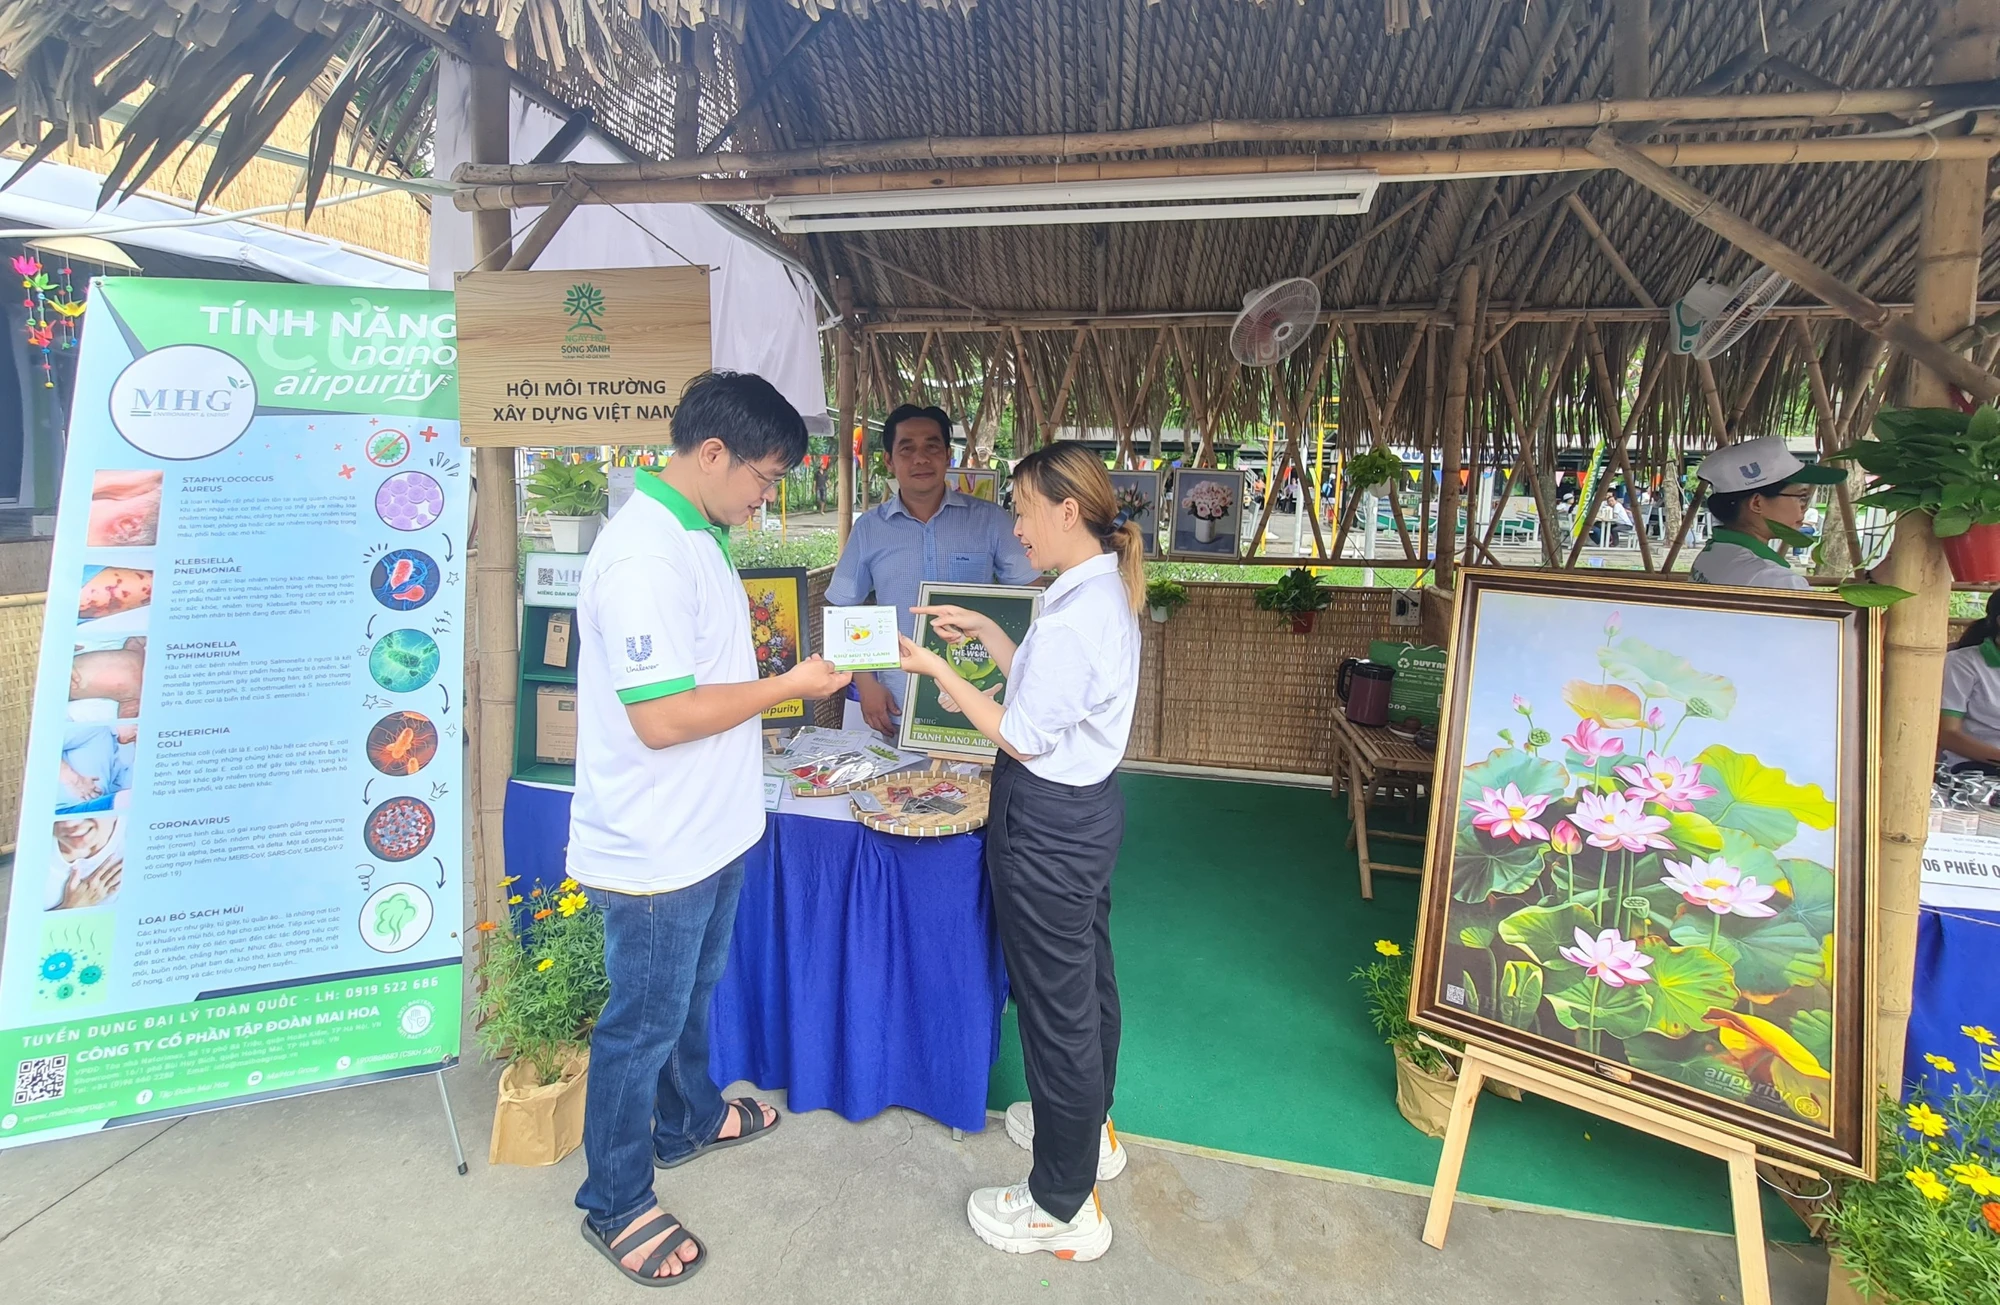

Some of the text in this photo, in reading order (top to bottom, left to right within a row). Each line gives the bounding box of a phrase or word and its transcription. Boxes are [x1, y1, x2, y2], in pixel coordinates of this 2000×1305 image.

[200, 300, 456, 338] TÍNH NĂNG
[350, 345, 457, 365] nano
[274, 368, 446, 403] airpurity
[507, 377, 666, 399] HỘI MÔI TRƯỜNG
[131, 388, 232, 411] MHG
[493, 404, 526, 421] XÂY
[532, 406, 588, 423] DỰNG
[593, 403, 631, 422] VIỆT
[182, 475, 274, 483] STAPHYLOCOCCUS
[181, 485, 222, 493] AUREUS
[175, 557, 234, 565] KLEBSIELLA
[174, 566, 242, 575] PNEUMONIAE
[166, 641, 237, 650] SALMONELLA
[166, 650, 240, 660] TYPHIMURIUM
[626, 664, 659, 674] Unilever
[158, 727, 231, 738] ESCHERICHIA
[912, 732, 941, 741] TRANH
[944, 736, 969, 744] NANO
[149, 816, 230, 830] CORONAVIRUS
[304, 844, 343, 854] SARS-CoV-2
[1944, 858, 1988, 876] PHIẾU
[138, 905, 244, 926] LOẠI BỎ SẠCH MÙI
[87, 1019, 137, 1038] DỤNG
[144, 1013, 173, 1029] ĐẠI
[179, 1007, 200, 1024] LÝ
[205, 1002, 250, 1020] TOÀN
[256, 994, 298, 1013] QUỐC
[315, 990, 340, 1003] LH:
[346, 983, 379, 999] 0919
[383, 981, 408, 993] 522
[413, 976, 439, 990] 686
[76, 1045, 129, 1063] CÔNG
[133, 1039, 155, 1053] TY
[186, 1026, 230, 1045] PHẦN
[234, 1022, 263, 1039] TẬP
[266, 1014, 312, 1032] ĐOÀN
[315, 1010, 344, 1025] MAI
[347, 1005, 380, 1020] HOA
[1704, 1067, 1791, 1102] airpurity
